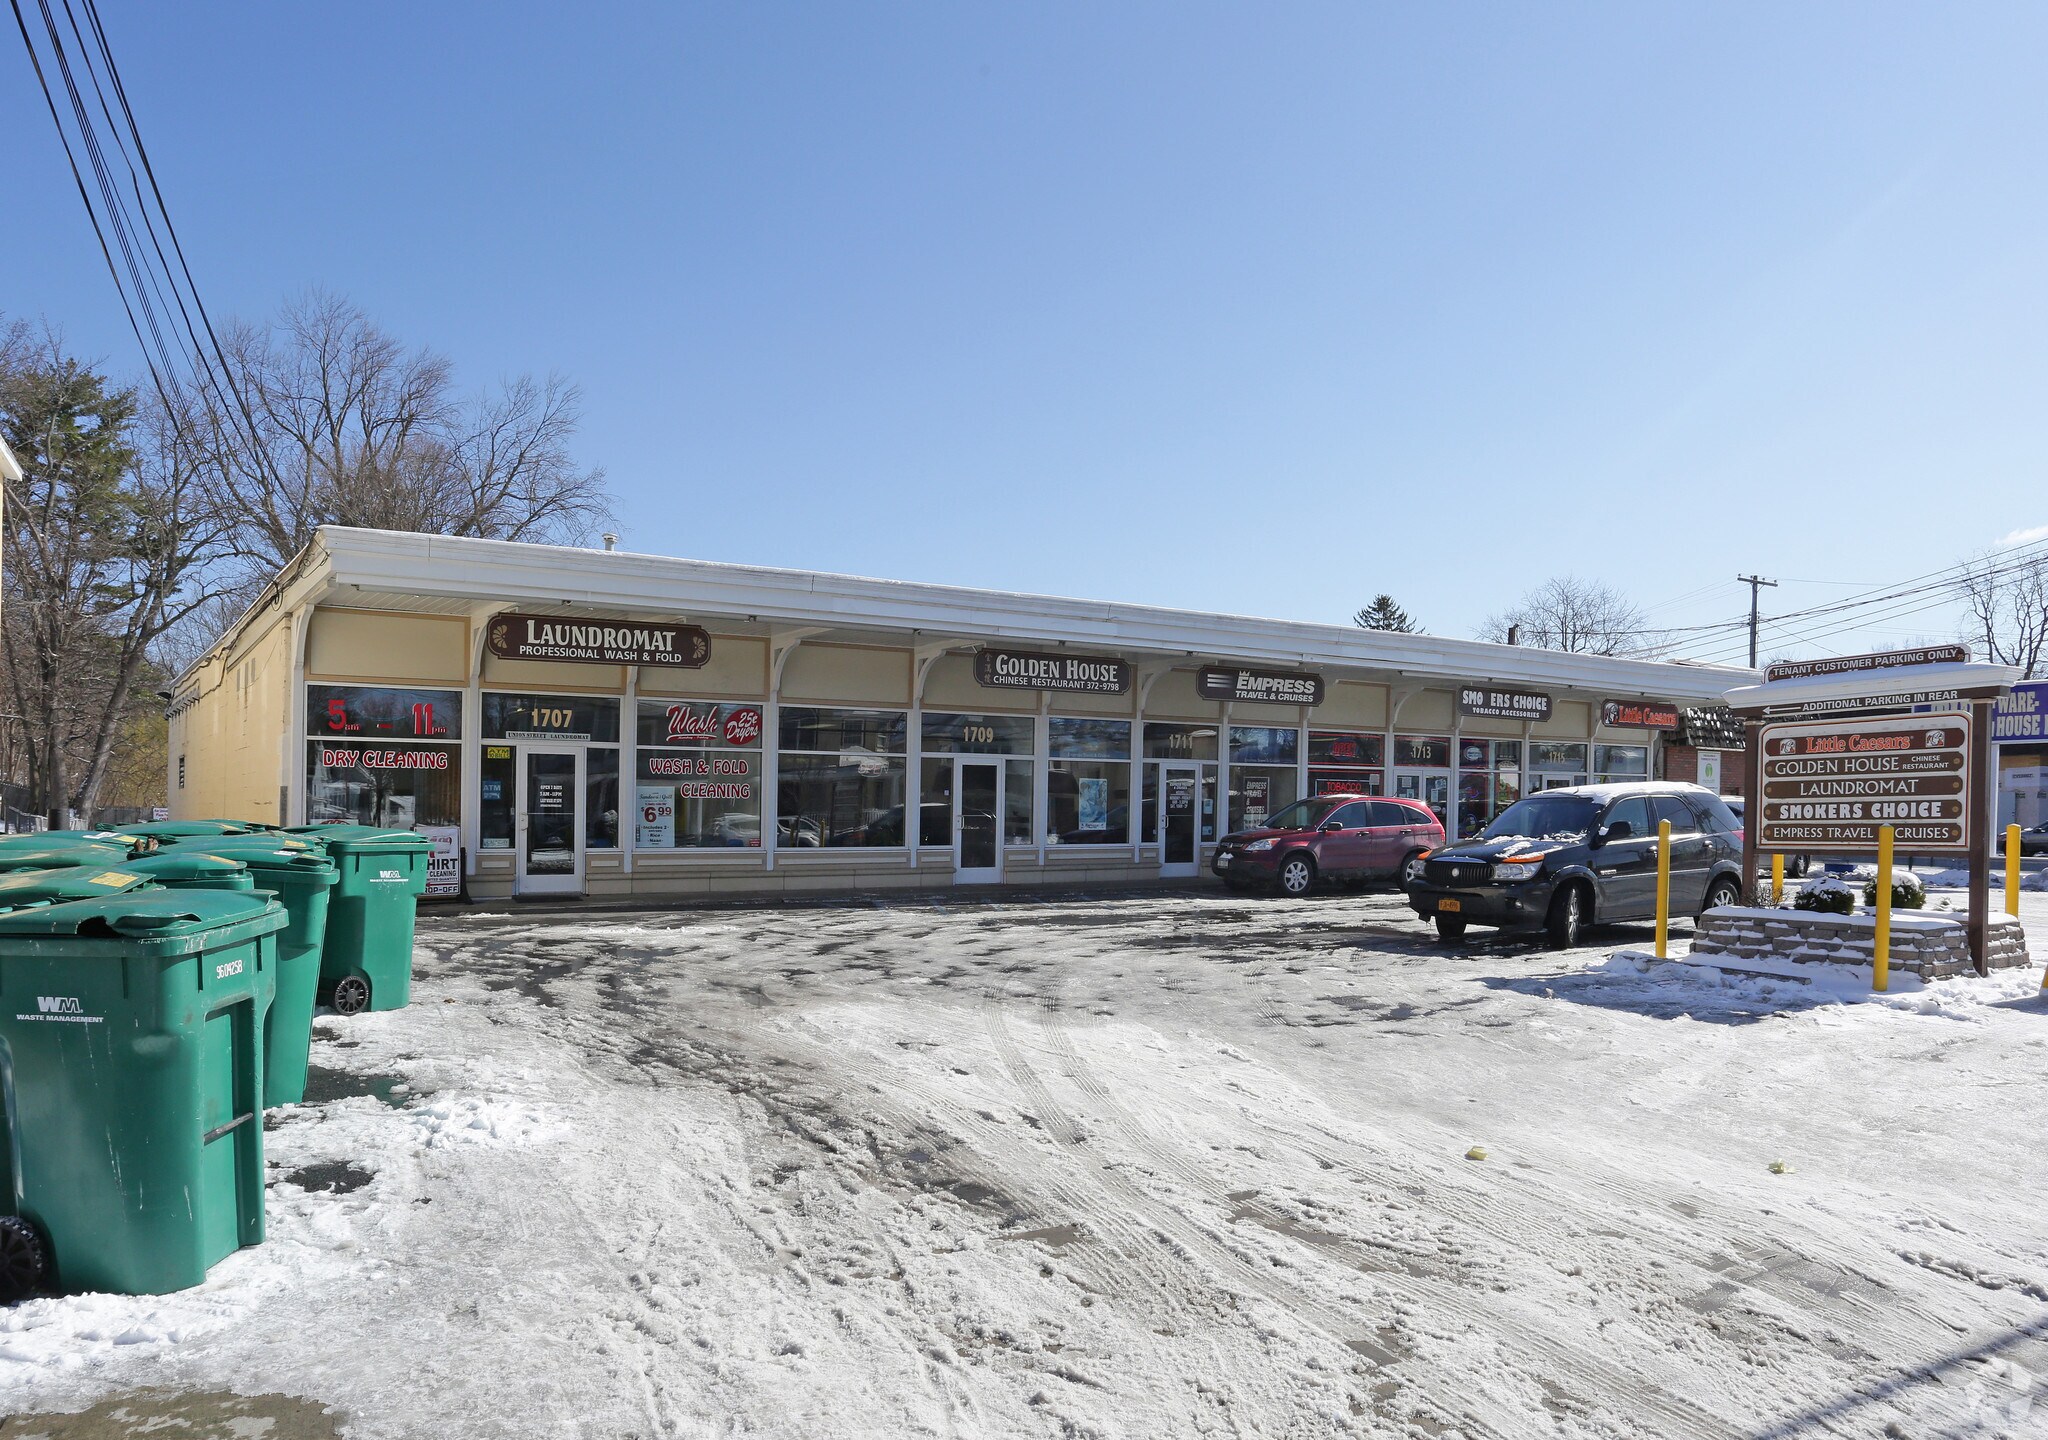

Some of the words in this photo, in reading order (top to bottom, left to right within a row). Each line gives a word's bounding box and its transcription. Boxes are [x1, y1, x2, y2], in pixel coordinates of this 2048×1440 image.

[526, 619, 677, 651] LAUNDROMAT
[519, 645, 600, 659] PROFESSIONAL
[604, 650, 638, 661] WASH
[642, 652, 650, 662] &
[655, 652, 682, 663] FOLD
[995, 654, 1059, 679] GOLDEN
[1066, 659, 1118, 682] HOUSE
[1773, 664, 1812, 677] TENANT
[1815, 659, 1872, 673] CUSTOMER
[1875, 653, 1924, 666] PARKING
[1927, 649, 1957, 660] ONLY
[993, 675, 1028, 686] CHINESE
[1032, 678, 1085, 689] RESTAURANT
[1086, 681, 1120, 691] 372-9798
[1236, 676, 1316, 694] EMPRESS
[1235, 690, 1268, 700] TRAVEL
[1269, 692, 1276, 700] &
[1278, 693, 1314, 703] CRUISES
[1512, 695, 1548, 711] CHOICE
[1802, 698, 1863, 712] ADDITIONAL
[1864, 694, 1911, 706] PARKING
[1914, 692, 1925, 702] IN
[1929, 690, 1958, 701] REAR
[1996, 691, 2040, 713] WARE-
[531, 708, 573, 728] 1707
[666, 705, 718, 734] Wash
[1472, 707, 1499, 715] TOBACCO
[1501, 709, 1540, 719] ACCESSORIES
[1618, 705, 1642, 723] Little
[1643, 707, 1677, 726] Caesars
[726, 720, 759, 742] Dryers
[963, 726, 994, 743] 1709
[1996, 715, 2041, 737] HOUSE
[1169, 734, 1193, 749] 1711
[1805, 735, 1846, 753] Little
[1848, 734, 1911, 751] Caesars
[323, 749, 359, 768] DRY
[362, 750, 447, 769] CLEANING
[1412, 745, 1432, 759] 1713
[1549, 751, 1565, 763] 1715
[650, 758, 693, 775] WASH
[696, 759, 709, 775] &
[713, 759, 749, 776] FOLD
[1775, 759, 1838, 775] GOLDEN
[1844, 757, 1899, 772] HOUSE
[1902, 762, 1949, 770] RESTAURANT
[680, 782, 751, 799] CLEANING
[1246, 781, 1267, 790] EMPRESS
[1327, 781, 1362, 792] TOBACCO
[1800, 779, 1919, 796] LAUNDROMAT
[1779, 803, 1863, 819] SMOKERS
[1870, 801, 1942, 818] CHOICE
[1773, 827, 1823, 839] EMPRESS
[1827, 827, 1874, 838] TRAVEL
[1894, 827, 1949, 839] CRUISES
[427, 859, 458, 870] HIRT
[429, 870, 457, 878] CLEANING
[37, 996, 83, 1013] WM
[46, 1015, 104, 1023] MANAGEMENT
